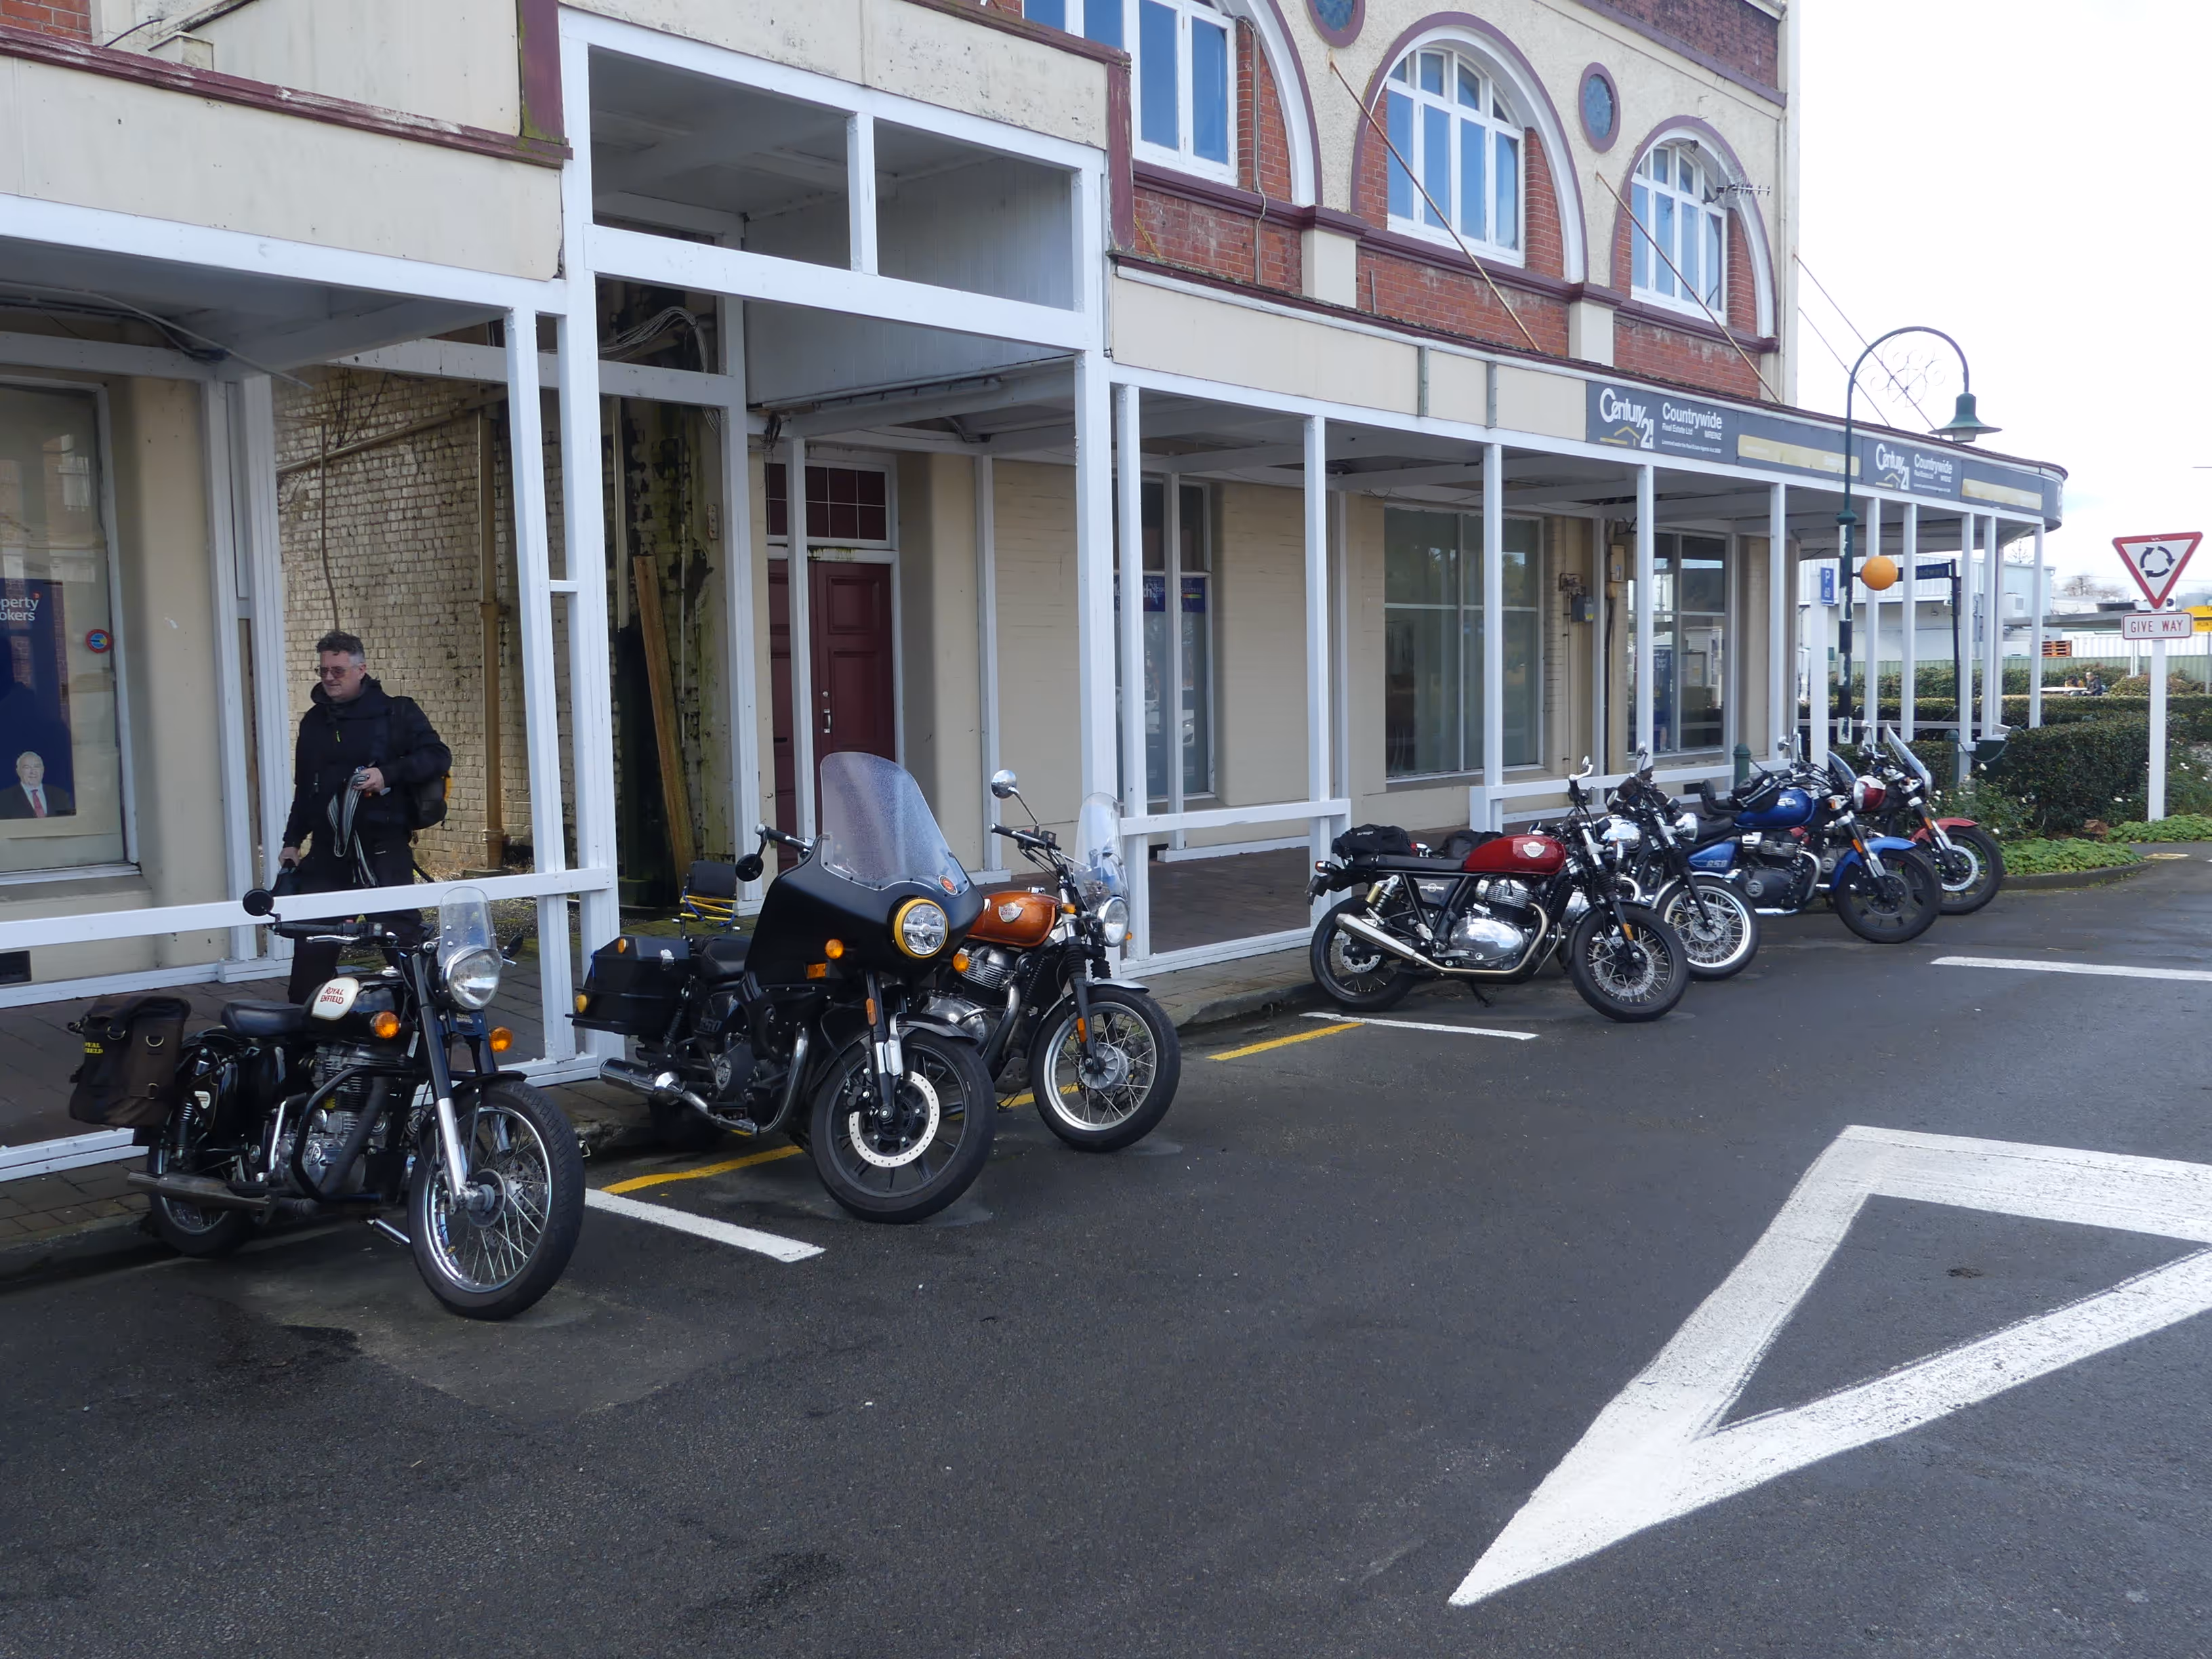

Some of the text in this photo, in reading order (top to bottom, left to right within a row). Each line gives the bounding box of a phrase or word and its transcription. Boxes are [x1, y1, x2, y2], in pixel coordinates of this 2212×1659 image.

[1600, 388, 1646, 428] Century
[1662, 402, 1723, 430] Countrywide
[1640, 417, 1654, 450] 21
[1876, 443, 1905, 474] Century
[1914, 453, 1952, 474] Countrywide
[1900, 466, 1910, 490] 21
[1825, 570, 1830, 583] P
[0, 596, 39, 610] perty
[2131, 619, 2184, 633] GIVE WAY
[320, 994, 344, 1004] ENFIELD
[325, 987, 344, 995] ROYAL
